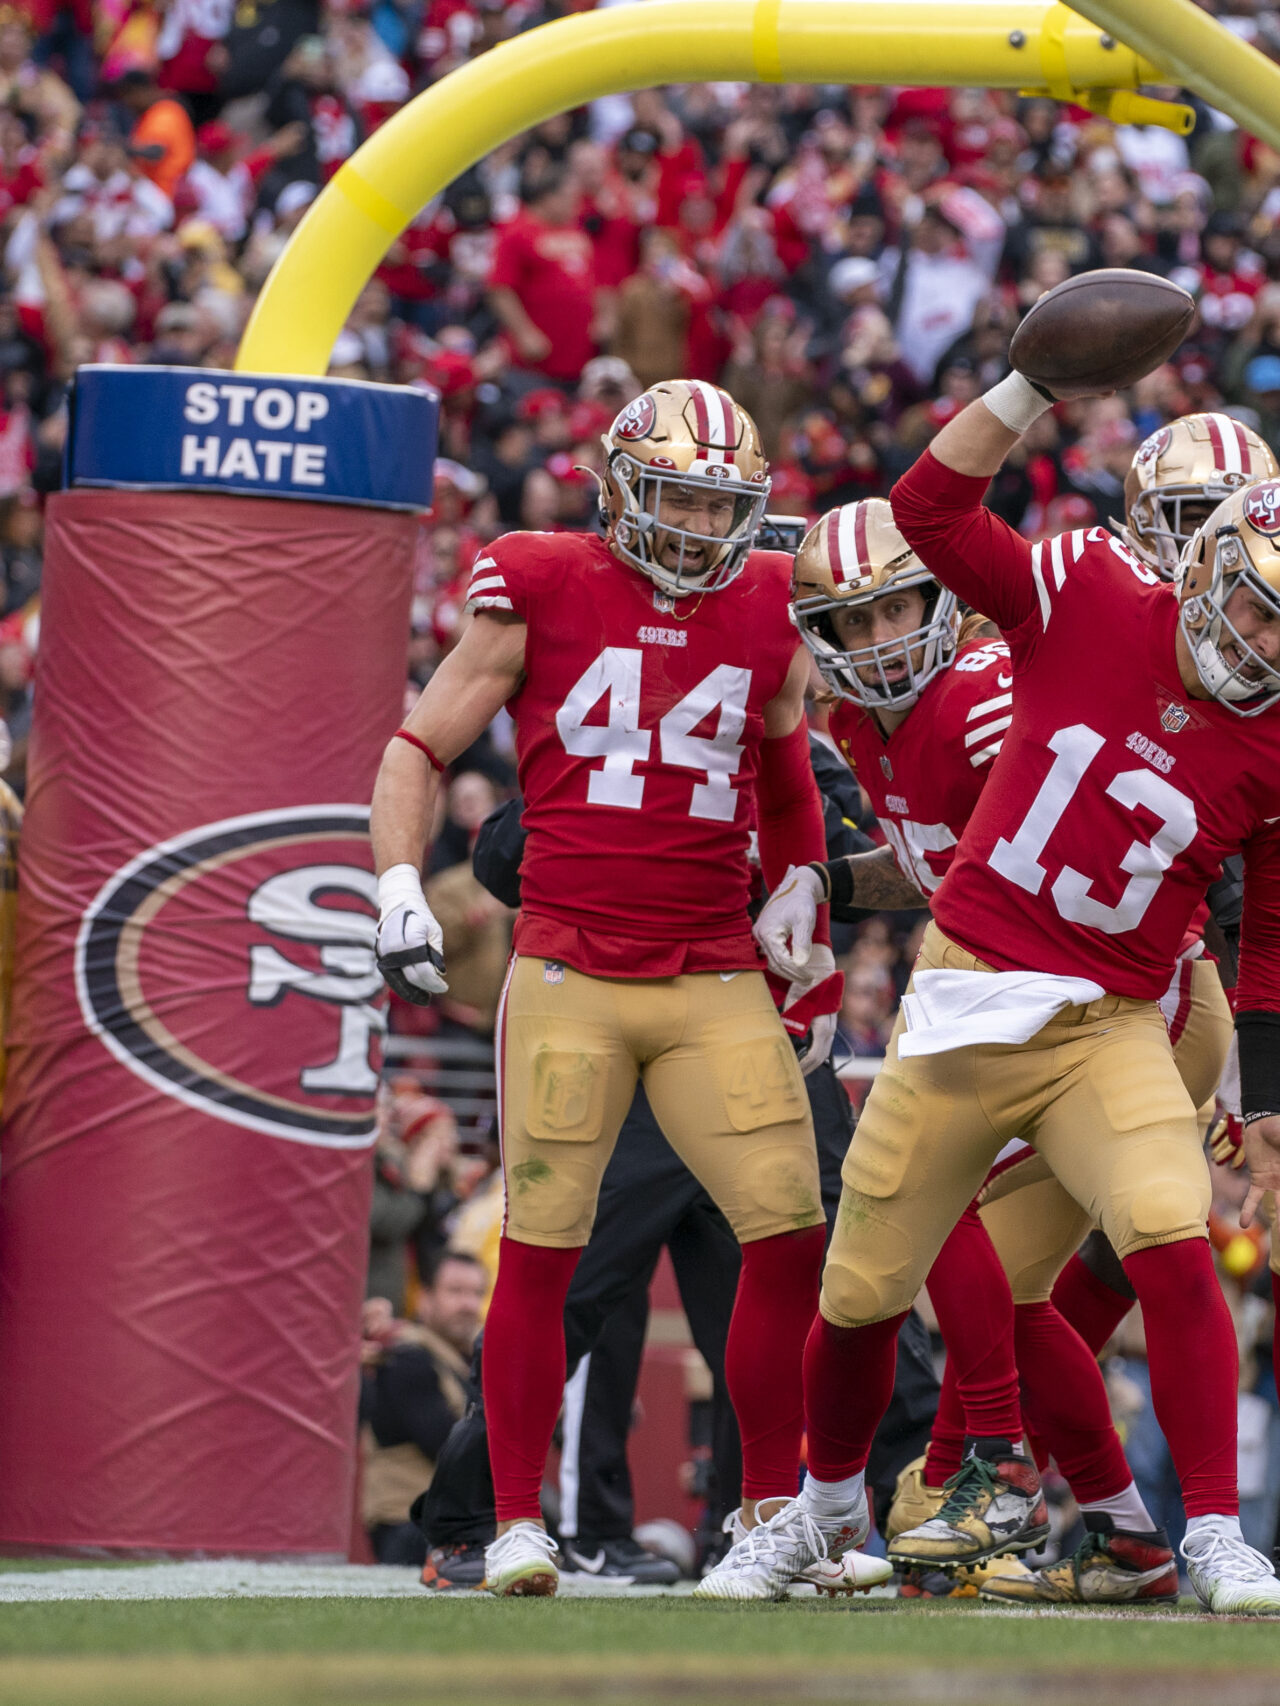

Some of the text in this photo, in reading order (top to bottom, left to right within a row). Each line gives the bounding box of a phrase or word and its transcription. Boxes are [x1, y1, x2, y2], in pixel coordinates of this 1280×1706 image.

[184, 382, 330, 432] STOP
[180, 434, 328, 486] HATE
[637, 625, 688, 647] 49ERS
[555, 646, 753, 823] 44
[1164, 713, 1181, 729] NFL
[1125, 731, 1177, 774] 49ERS
[987, 723, 1199, 934] 13
